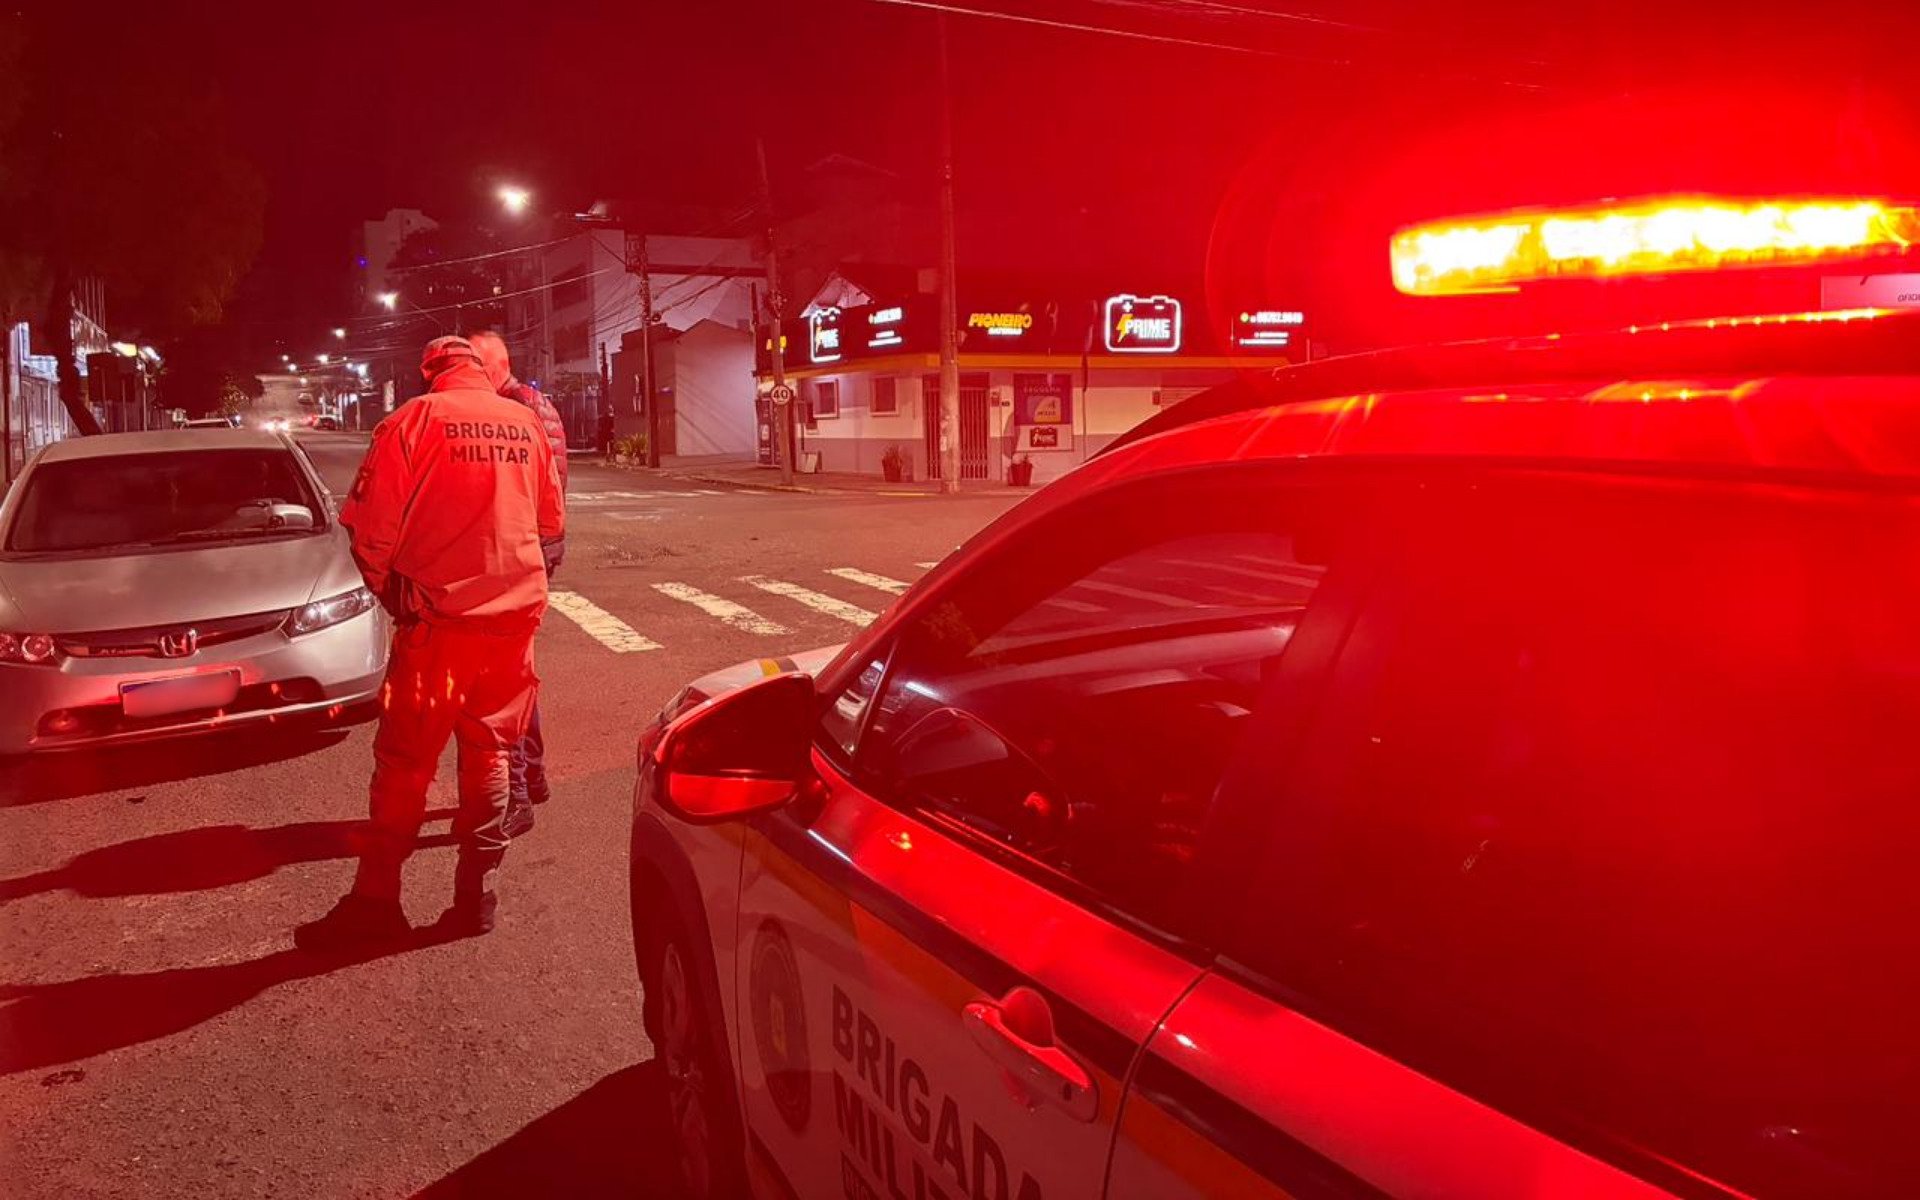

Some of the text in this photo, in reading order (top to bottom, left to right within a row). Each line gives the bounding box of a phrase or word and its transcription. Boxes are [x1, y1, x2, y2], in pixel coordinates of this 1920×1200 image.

[968, 313, 1033, 328] PIONEIRO
[1124, 318, 1171, 333] PRIME
[773, 389, 788, 400] 40
[445, 422, 531, 443] BRIGADA
[449, 445, 529, 464] MILITAR
